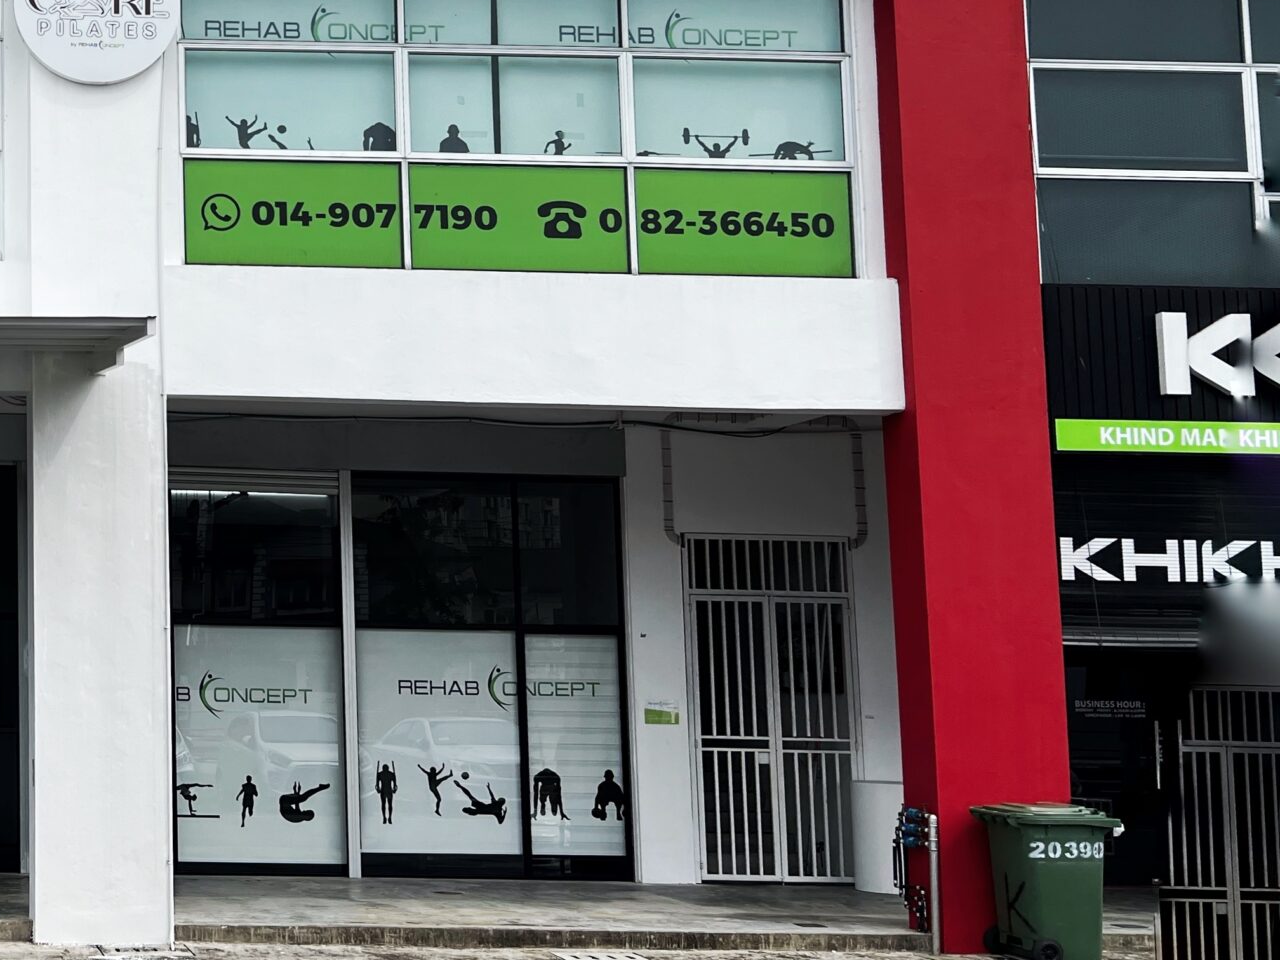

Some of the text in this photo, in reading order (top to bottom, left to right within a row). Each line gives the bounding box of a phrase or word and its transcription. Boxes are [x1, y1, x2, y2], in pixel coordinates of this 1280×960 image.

[36, 19, 158, 39] PILATES
[204, 19, 301, 39] REHAB
[251, 200, 397, 229] 014-907
[414, 204, 498, 231] 7190
[1099, 426, 1175, 447] KHIND
[398, 679, 480, 696] REHAB
[1074, 699, 1115, 708] BUSINESS
[1028, 841, 1105, 859] 20390
